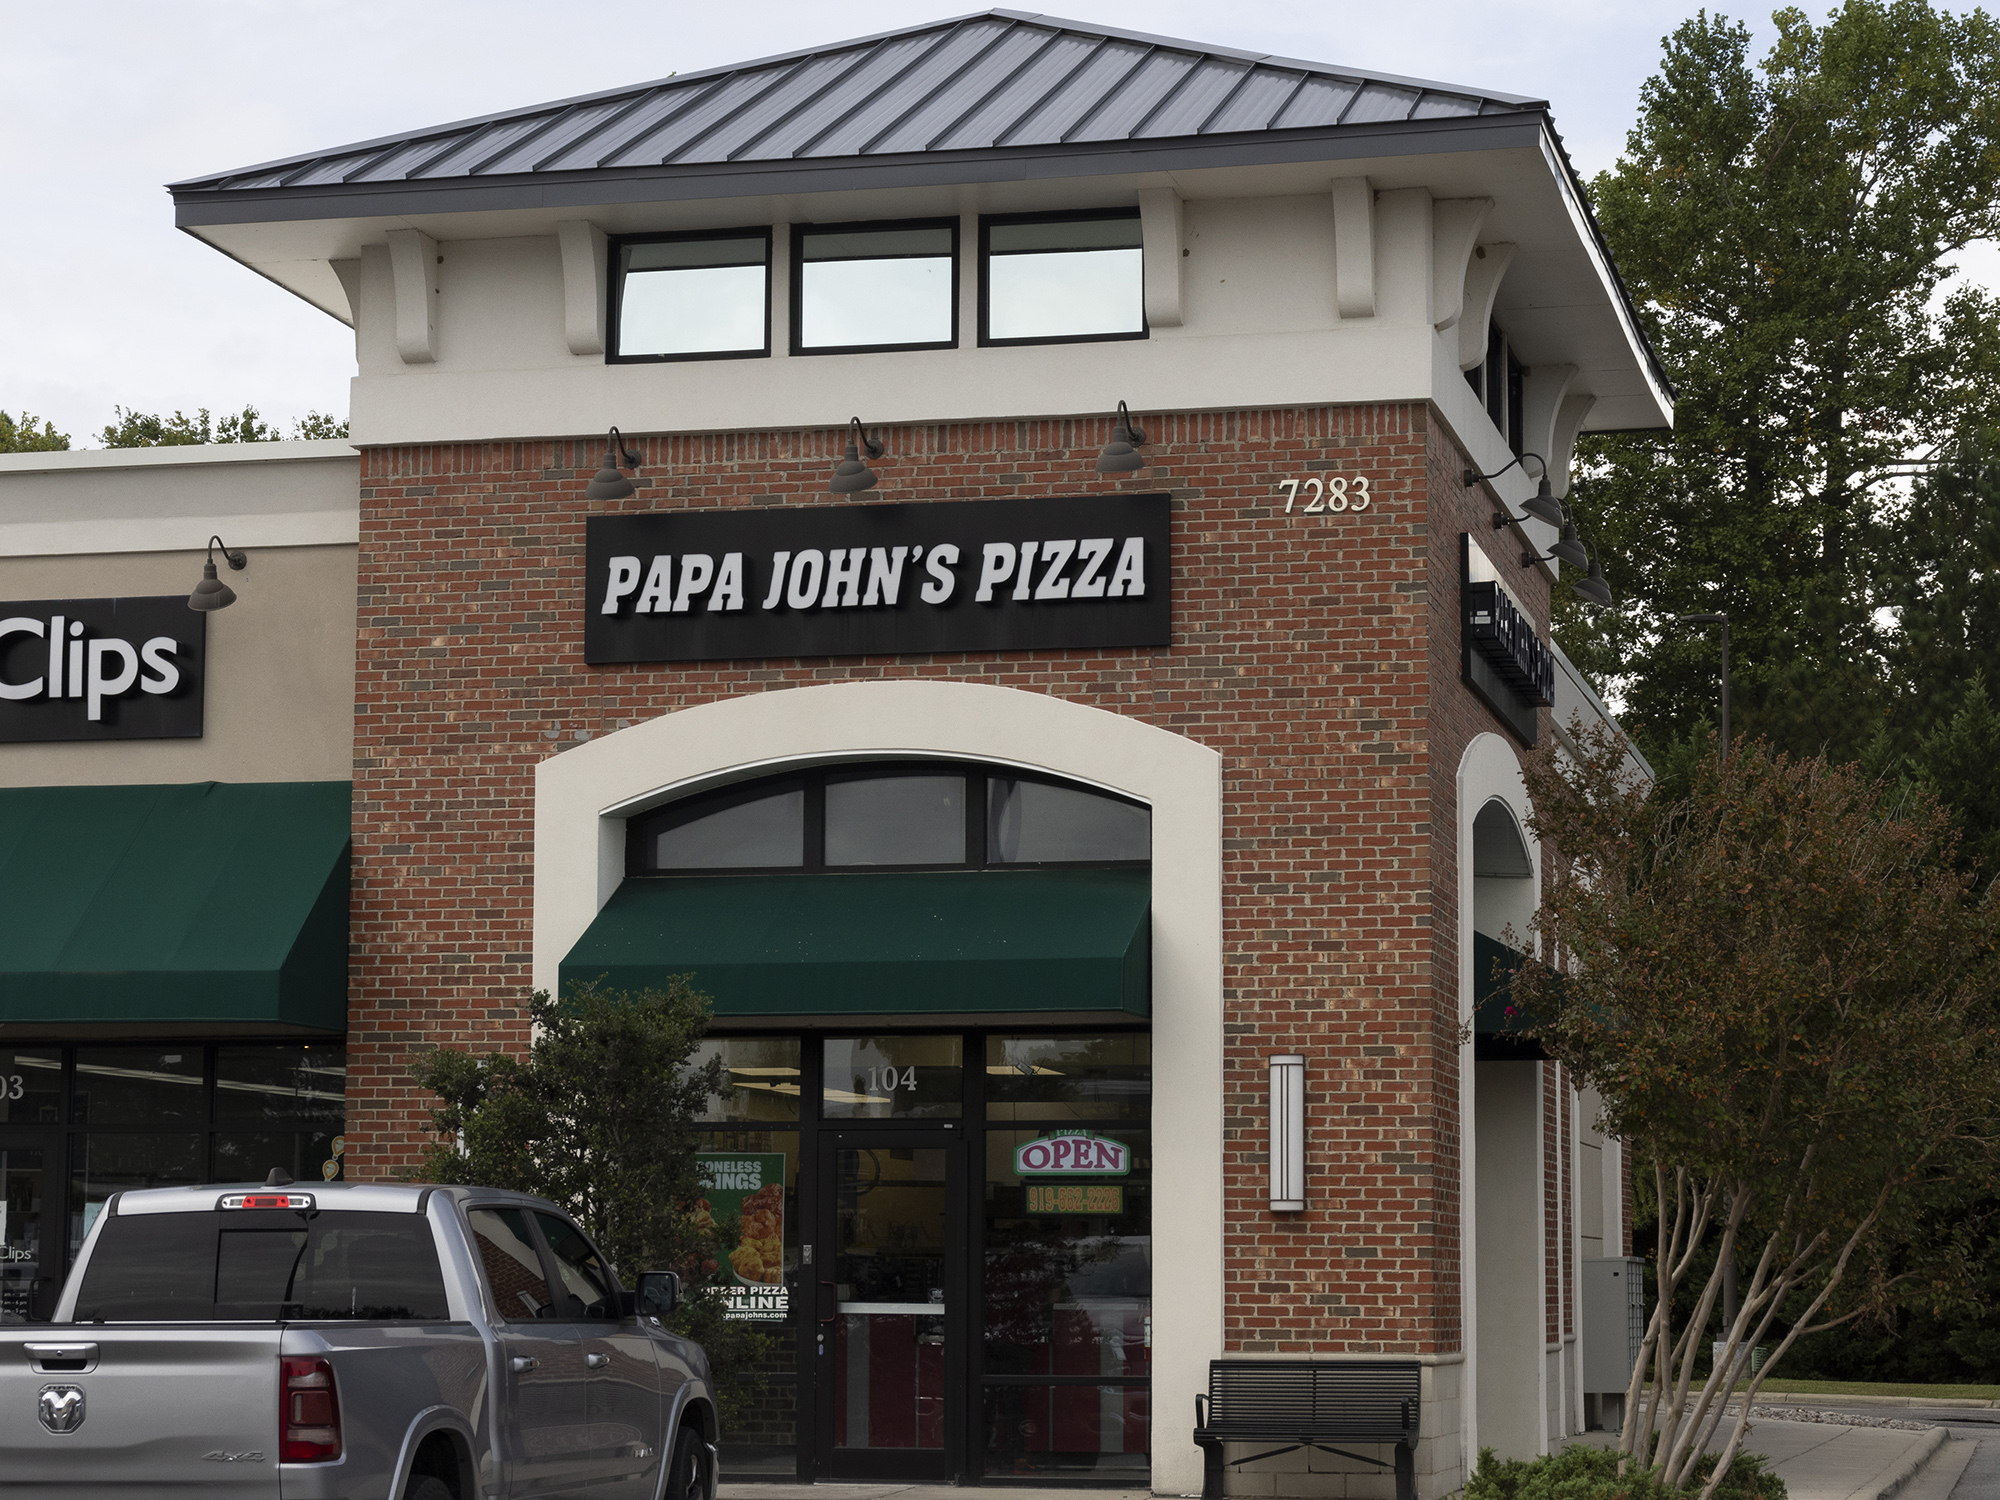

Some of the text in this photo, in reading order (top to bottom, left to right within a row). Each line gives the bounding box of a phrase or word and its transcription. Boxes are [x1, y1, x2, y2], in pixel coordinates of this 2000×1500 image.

[1279, 476, 1371, 514] 7283
[601, 536, 1147, 615] PAPA JOHN'S PIZZA
[0, 615, 181, 721] Clips
[868, 1065, 918, 1092] 104
[1022, 1139, 1123, 1169] OPEN
[1029, 1187, 1120, 1212] 919-662-2226
[703, 1296, 789, 1309] NLINE
[750, 1286, 789, 1295] PIZZA
